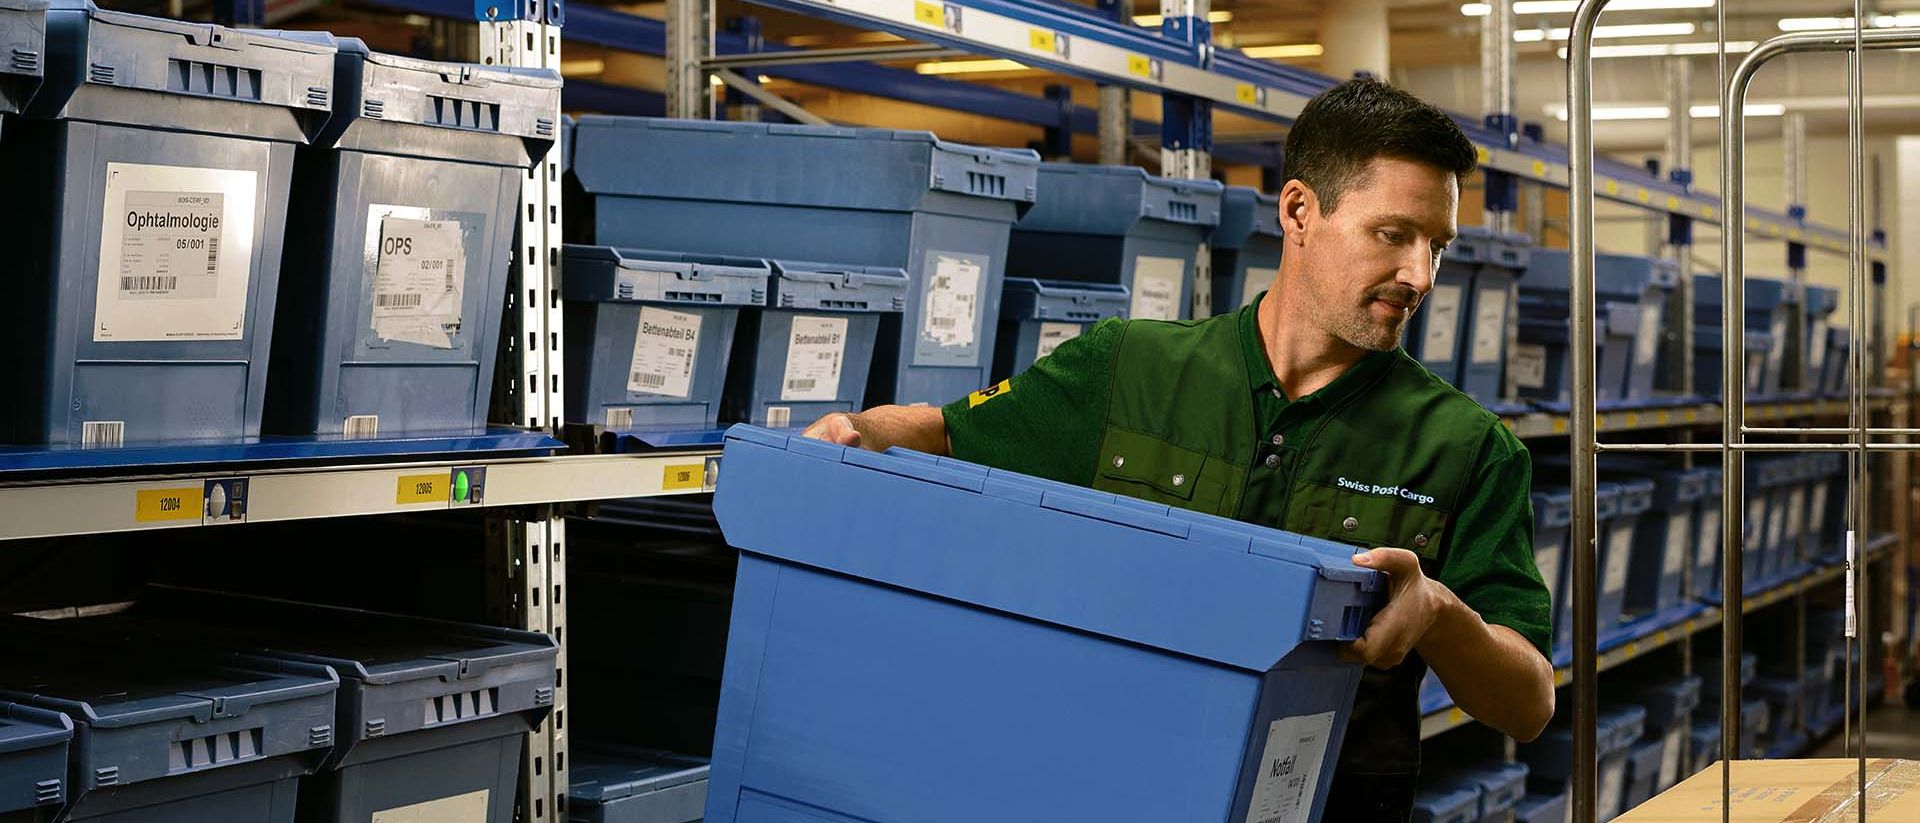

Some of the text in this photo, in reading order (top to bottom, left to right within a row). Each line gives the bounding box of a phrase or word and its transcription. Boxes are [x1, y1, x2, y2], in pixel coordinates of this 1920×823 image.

[127, 211, 219, 232] Ophtalmologie
[176, 239, 205, 250] 05/001
[384, 237, 412, 256] OPS
[421, 260, 443, 270] 02/001
[642, 321, 696, 341] Bettenabteil B4
[416, 482, 433, 495] 12005
[1337, 477, 1435, 504] Swiss Post Cargo
[160, 498, 181, 511] 12004
[1269, 754, 1298, 778] Notfall
